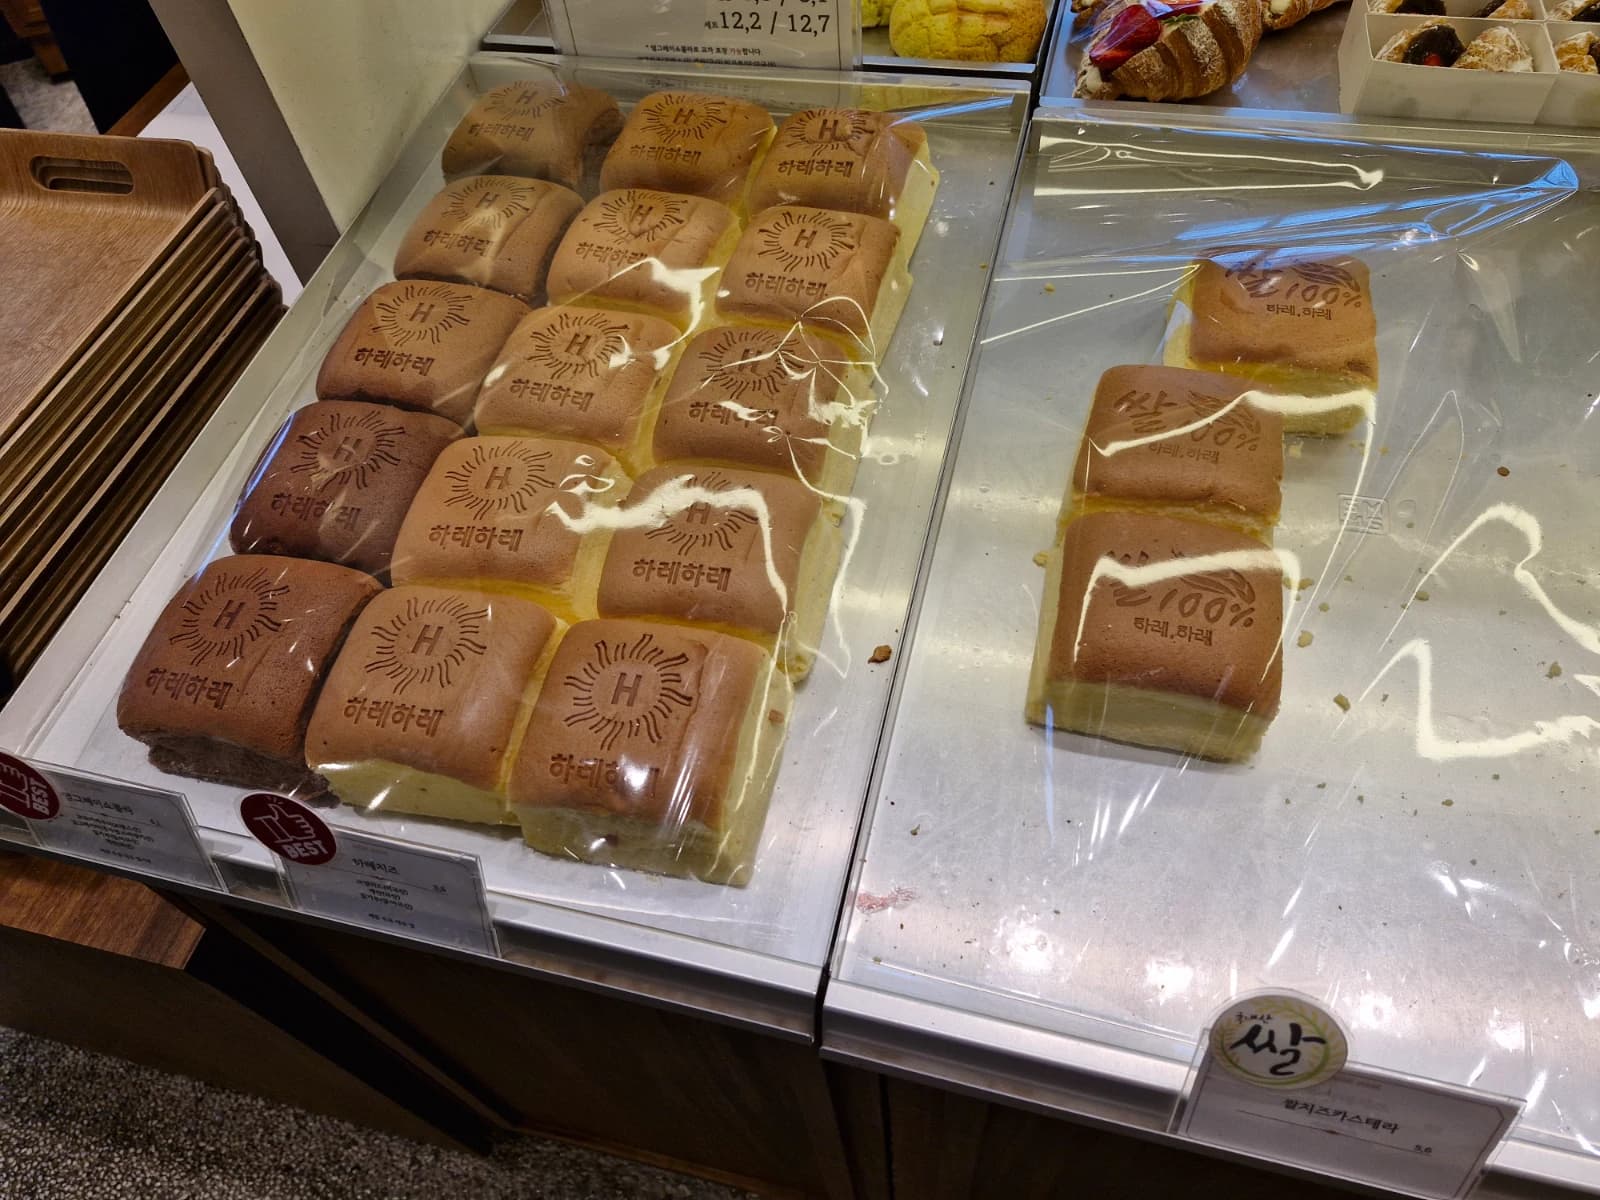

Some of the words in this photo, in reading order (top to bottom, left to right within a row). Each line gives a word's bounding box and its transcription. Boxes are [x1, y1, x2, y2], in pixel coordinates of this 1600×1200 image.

[720, 11, 762, 34] 12,2
[788, 13, 831, 37] 12,7
[515, 89, 534, 104] H
[674, 107, 695, 124] H
[819, 119, 841, 139] H
[630, 143, 702, 167] 하레하레
[778, 159, 854, 178] 하레하레
[476, 191, 500, 210] H
[631, 205, 652, 225] H
[423, 230, 494, 258] 하레하레
[795, 229, 817, 249] H
[575, 241, 647, 271] 하레하레
[745, 272, 828, 298] 하레하레
[1286, 283, 1362, 309] 100%
[409, 304, 434, 321] H
[567, 334, 590, 354] H
[355, 348, 434, 377] 하레하레
[510, 378, 593, 412] 하레하레
[332, 436, 360, 461] H
[485, 466, 511, 489] H
[271, 493, 361, 528] 하레하레
[688, 503, 712, 525] H
[429, 525, 523, 552] 하레하레
[633, 558, 732, 592] 하레하레
[214, 600, 245, 629] H
[1160, 588, 1256, 628] 100%
[411, 624, 443, 655] H
[146, 667, 231, 709] 하레하레
[611, 673, 643, 706] H
[343, 697, 444, 738] 하레하레
[29, 776, 49, 815] BEST
[281, 840, 329, 860] BEST
[1229, 1022, 1327, 1076] 쌀
